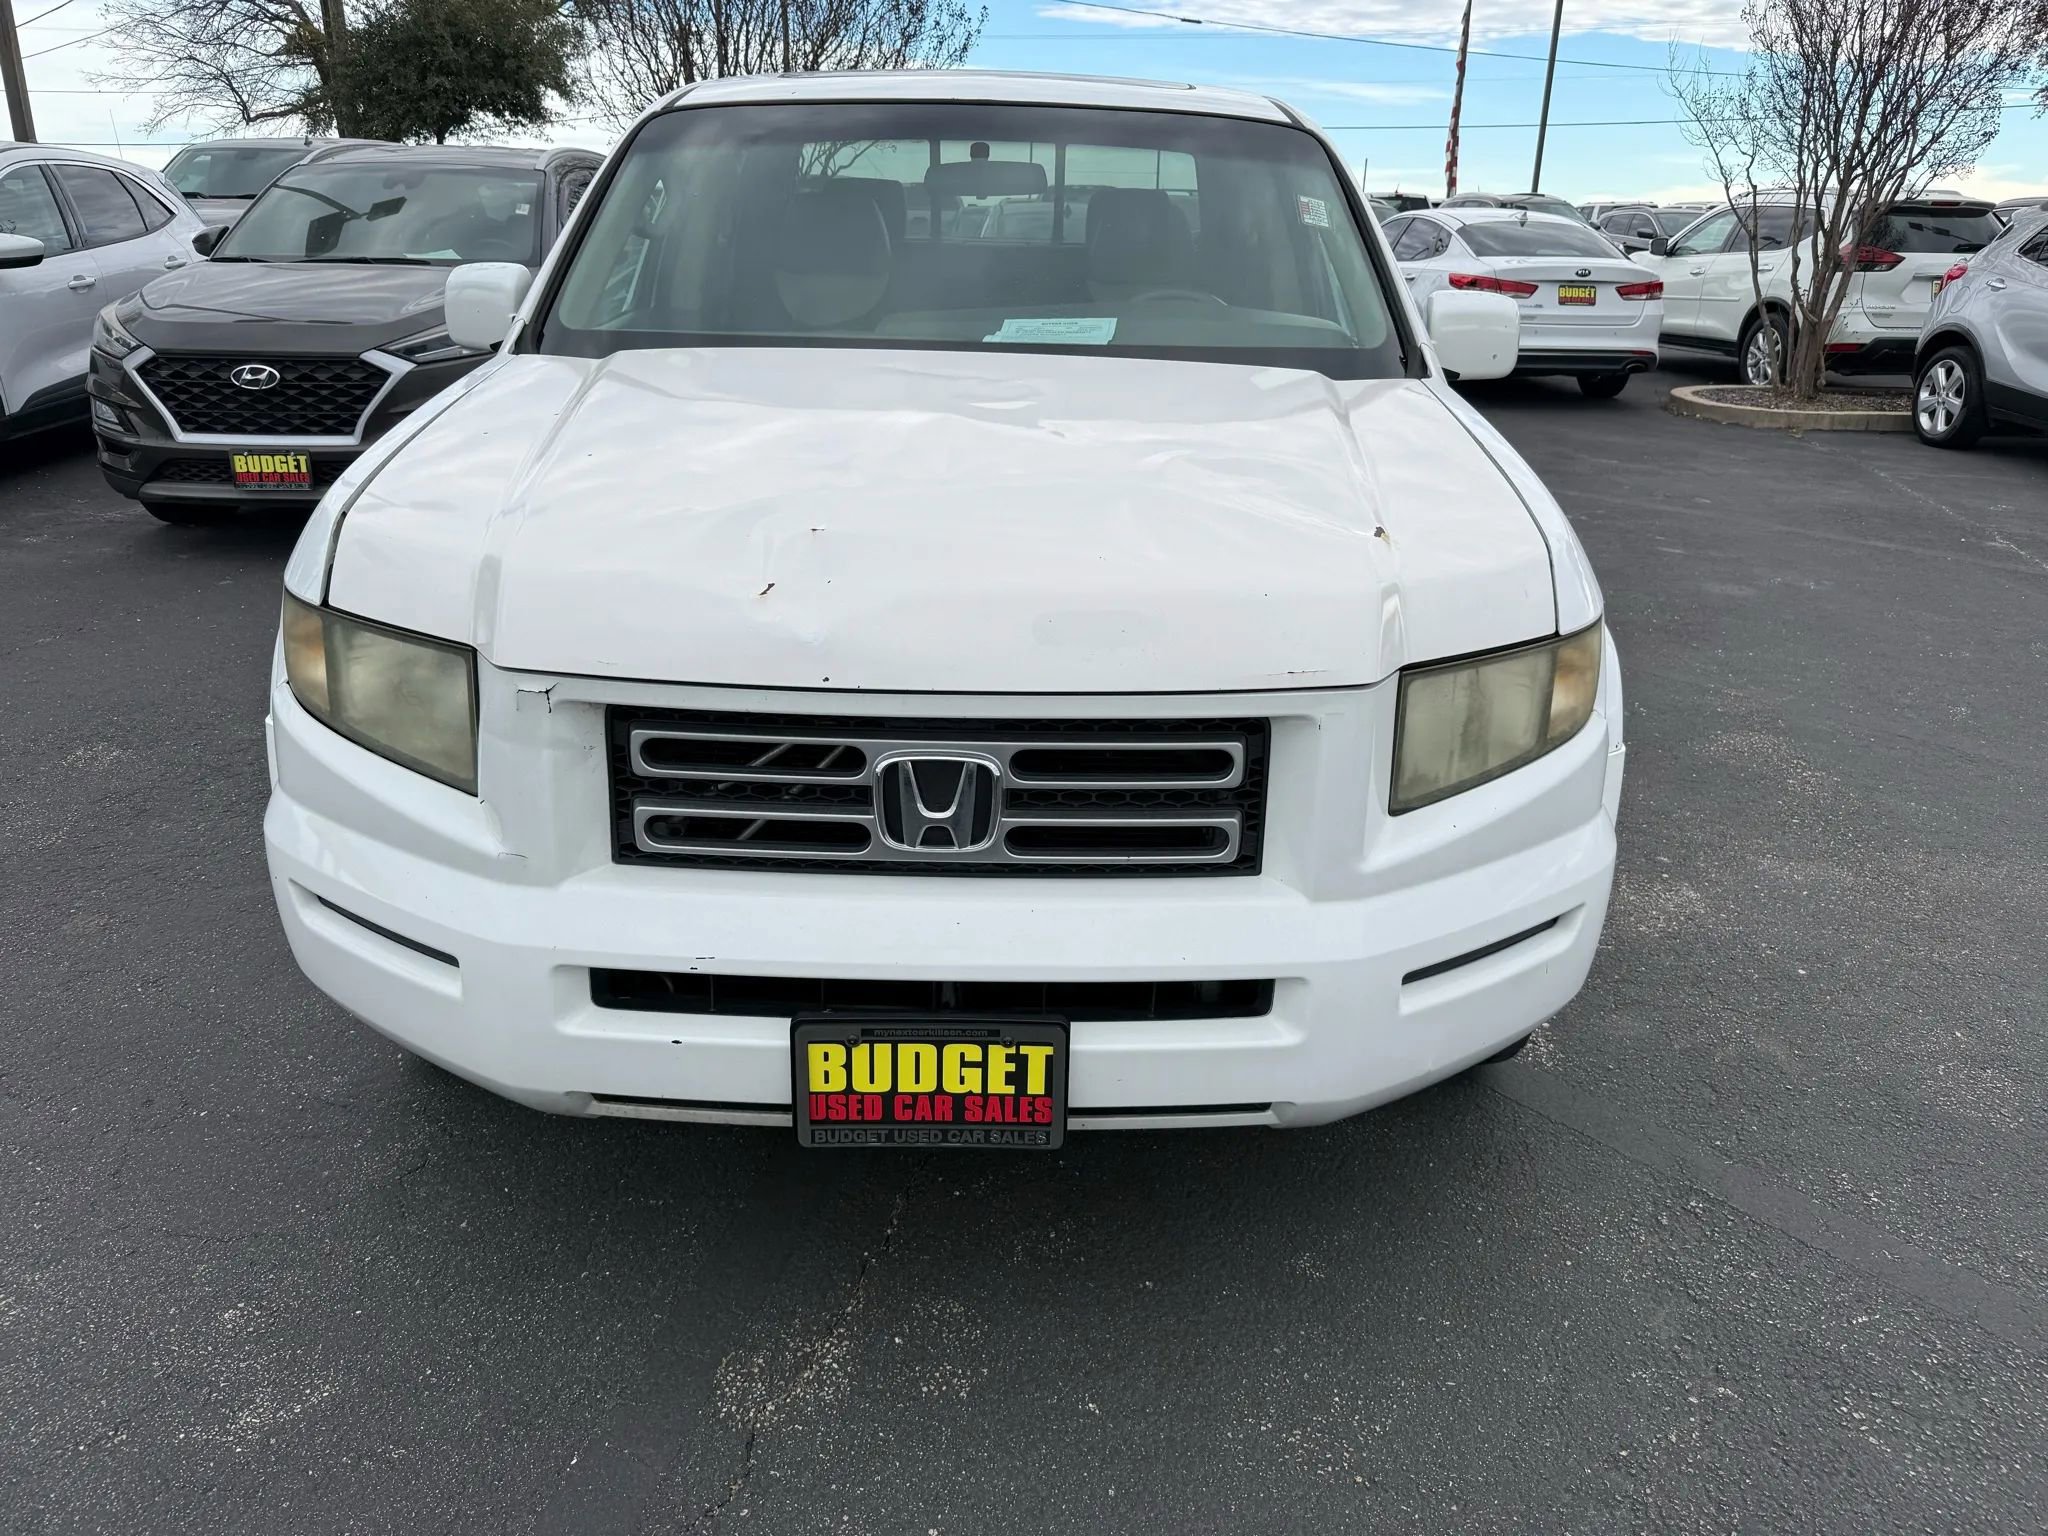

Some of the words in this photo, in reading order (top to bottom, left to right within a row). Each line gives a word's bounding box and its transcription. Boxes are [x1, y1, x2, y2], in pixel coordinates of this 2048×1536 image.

[1559, 287, 1596, 298] BUDGET
[233, 455, 308, 473] BUDGET
[262, 473, 281, 482] CAR
[808, 1043, 1054, 1095] BUDGET
[810, 1094, 883, 1121] USED
[894, 1095, 953, 1121] CAR
[964, 1096, 1054, 1123] SALES
[814, 1129, 889, 1144] BUDGET
[894, 1129, 943, 1144] USED
[947, 1129, 986, 1144] CAR
[989, 1129, 1048, 1145] SALES
